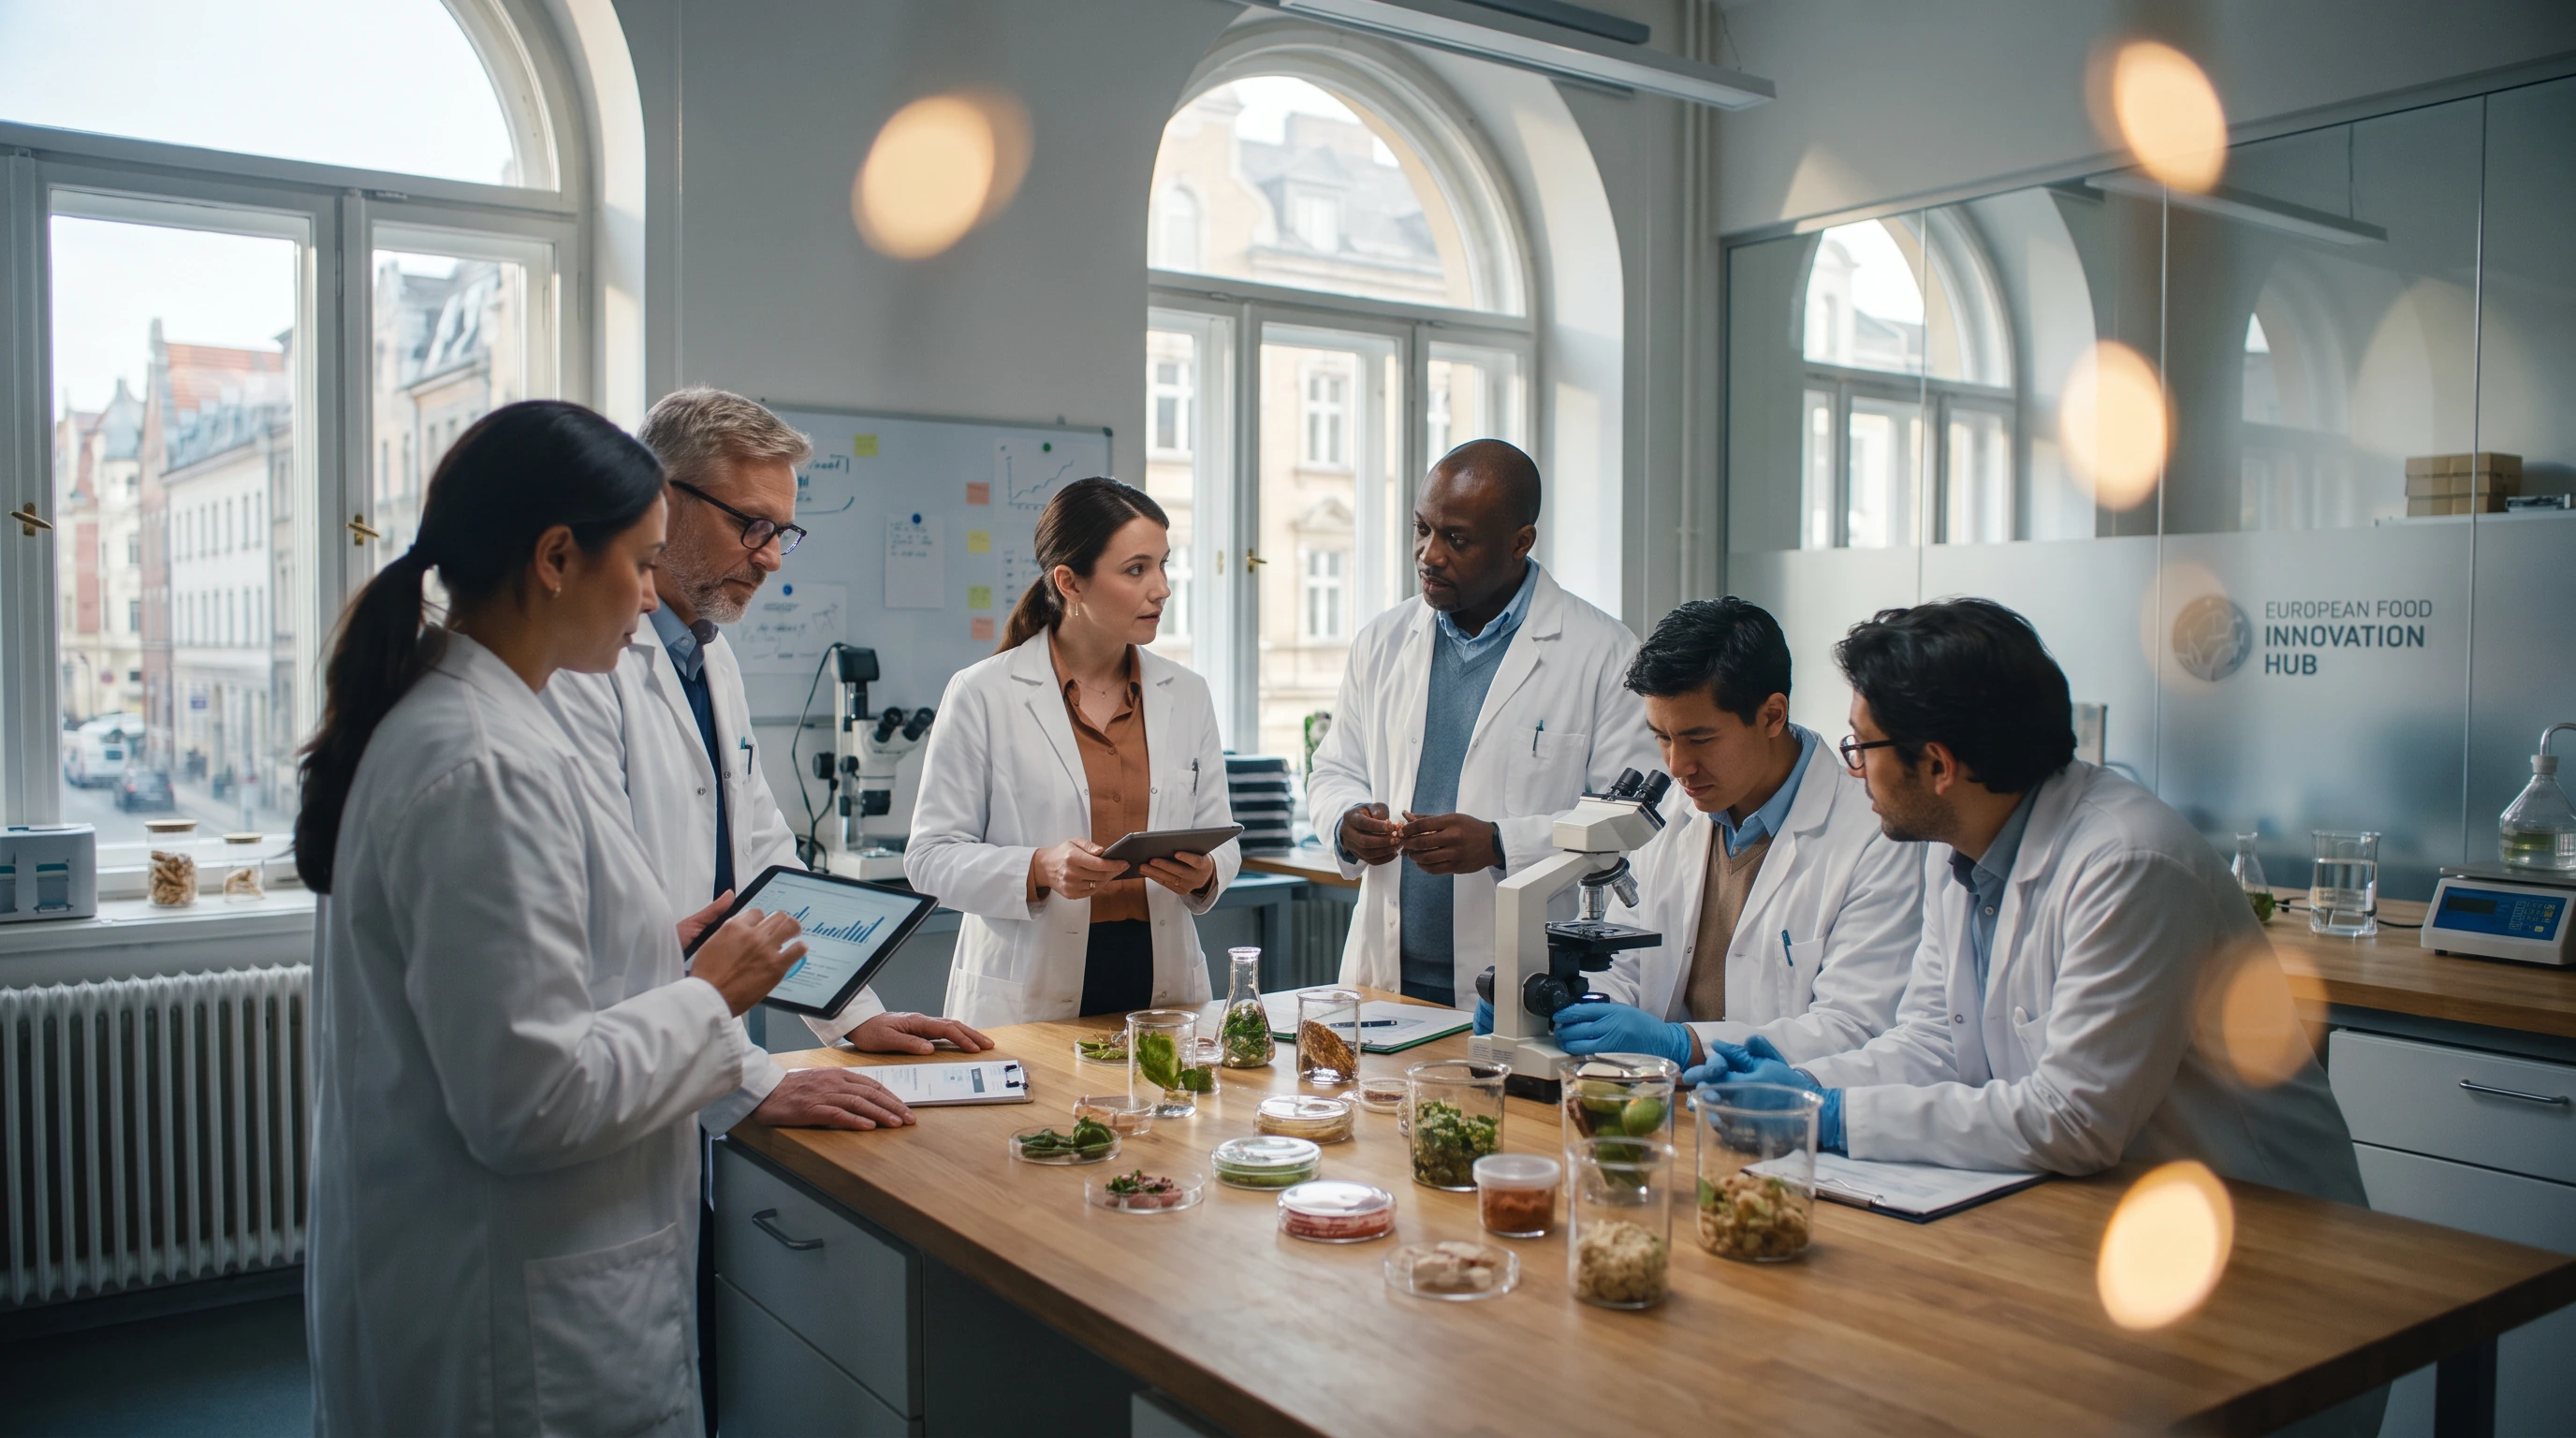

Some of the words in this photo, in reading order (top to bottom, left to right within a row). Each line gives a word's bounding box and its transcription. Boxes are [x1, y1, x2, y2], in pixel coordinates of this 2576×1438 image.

[2265, 601, 2369, 619] EUROPEAN
[2377, 599, 2433, 618] FOOD
[2265, 624, 2424, 648] INNOVATION
[2265, 653, 2318, 676] HUB
